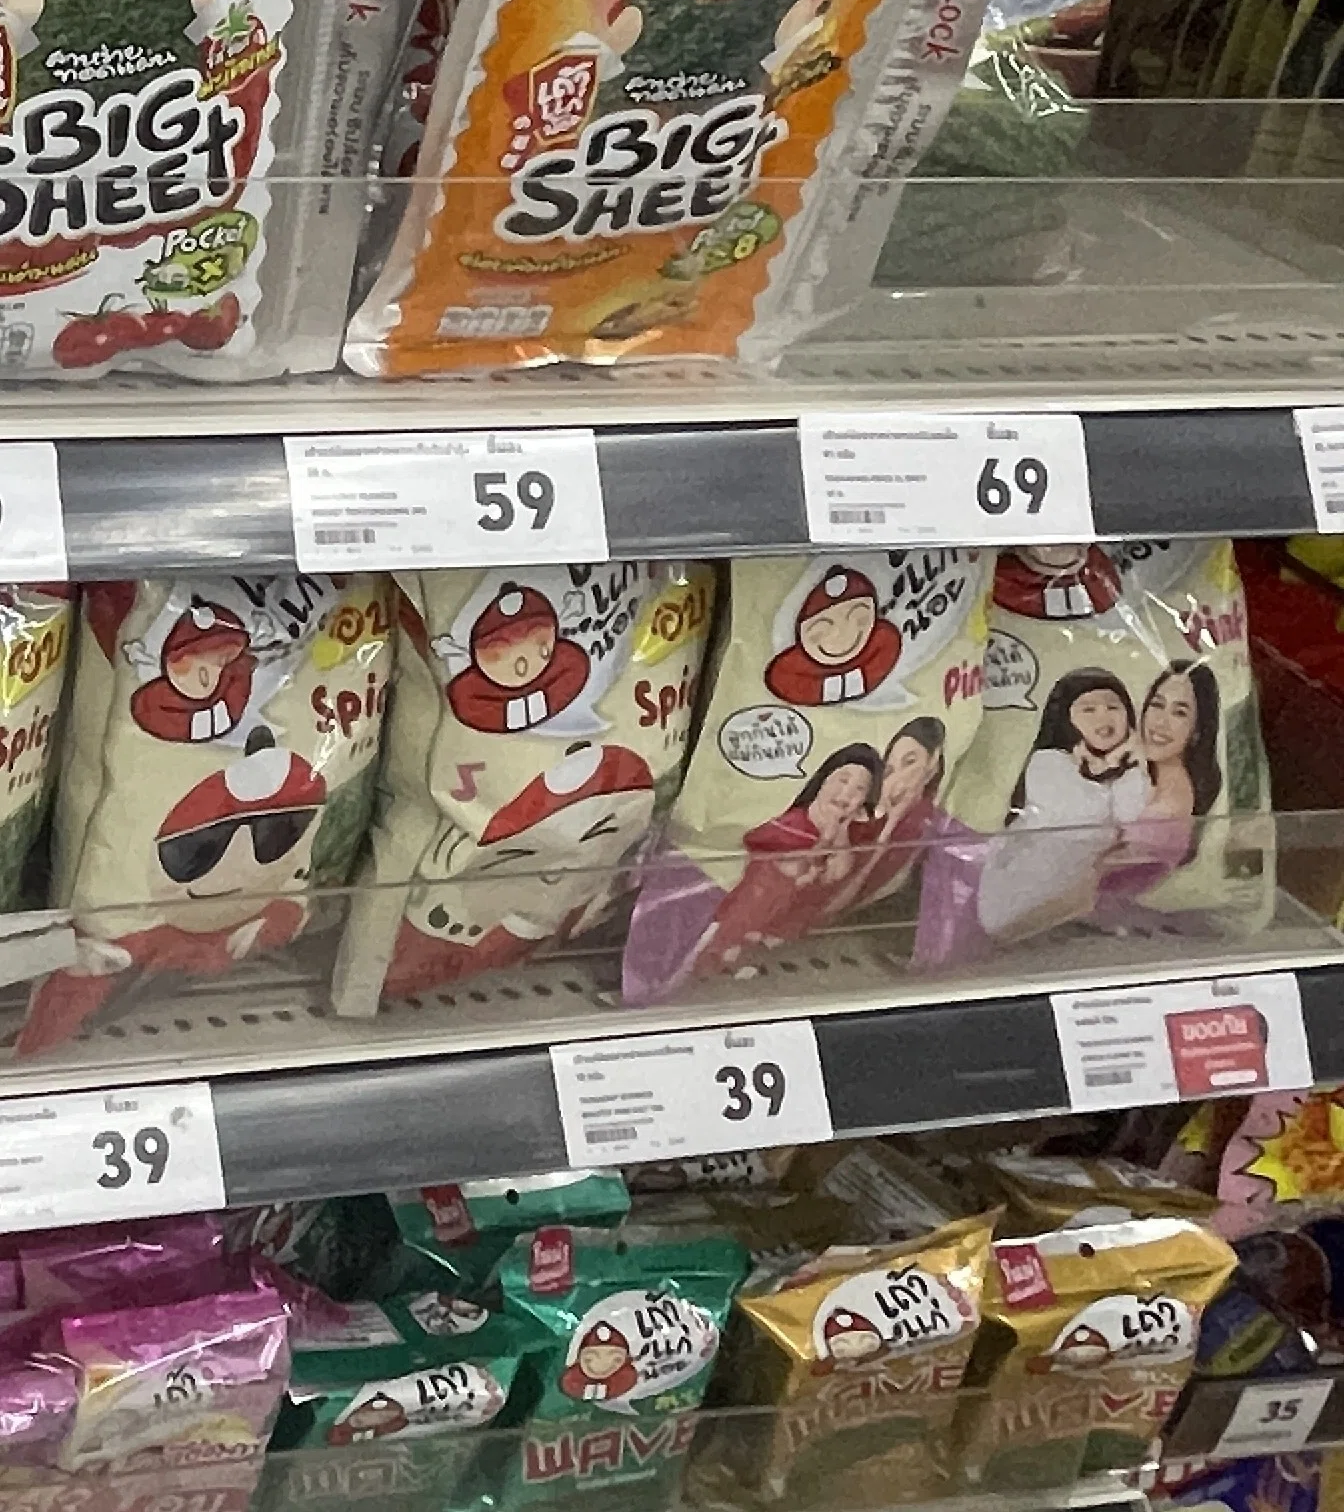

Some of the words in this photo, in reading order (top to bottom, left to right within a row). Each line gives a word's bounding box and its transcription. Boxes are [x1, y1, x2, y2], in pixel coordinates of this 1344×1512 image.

[23, 78, 202, 174] BIG
[584, 101, 760, 181] BIG
[473, 469, 557, 533] 59
[975, 457, 1050, 517] 69
[714, 1061, 787, 1122] 39
[91, 1125, 170, 1190] 39
[1259, 1397, 1302, 1426] 35
